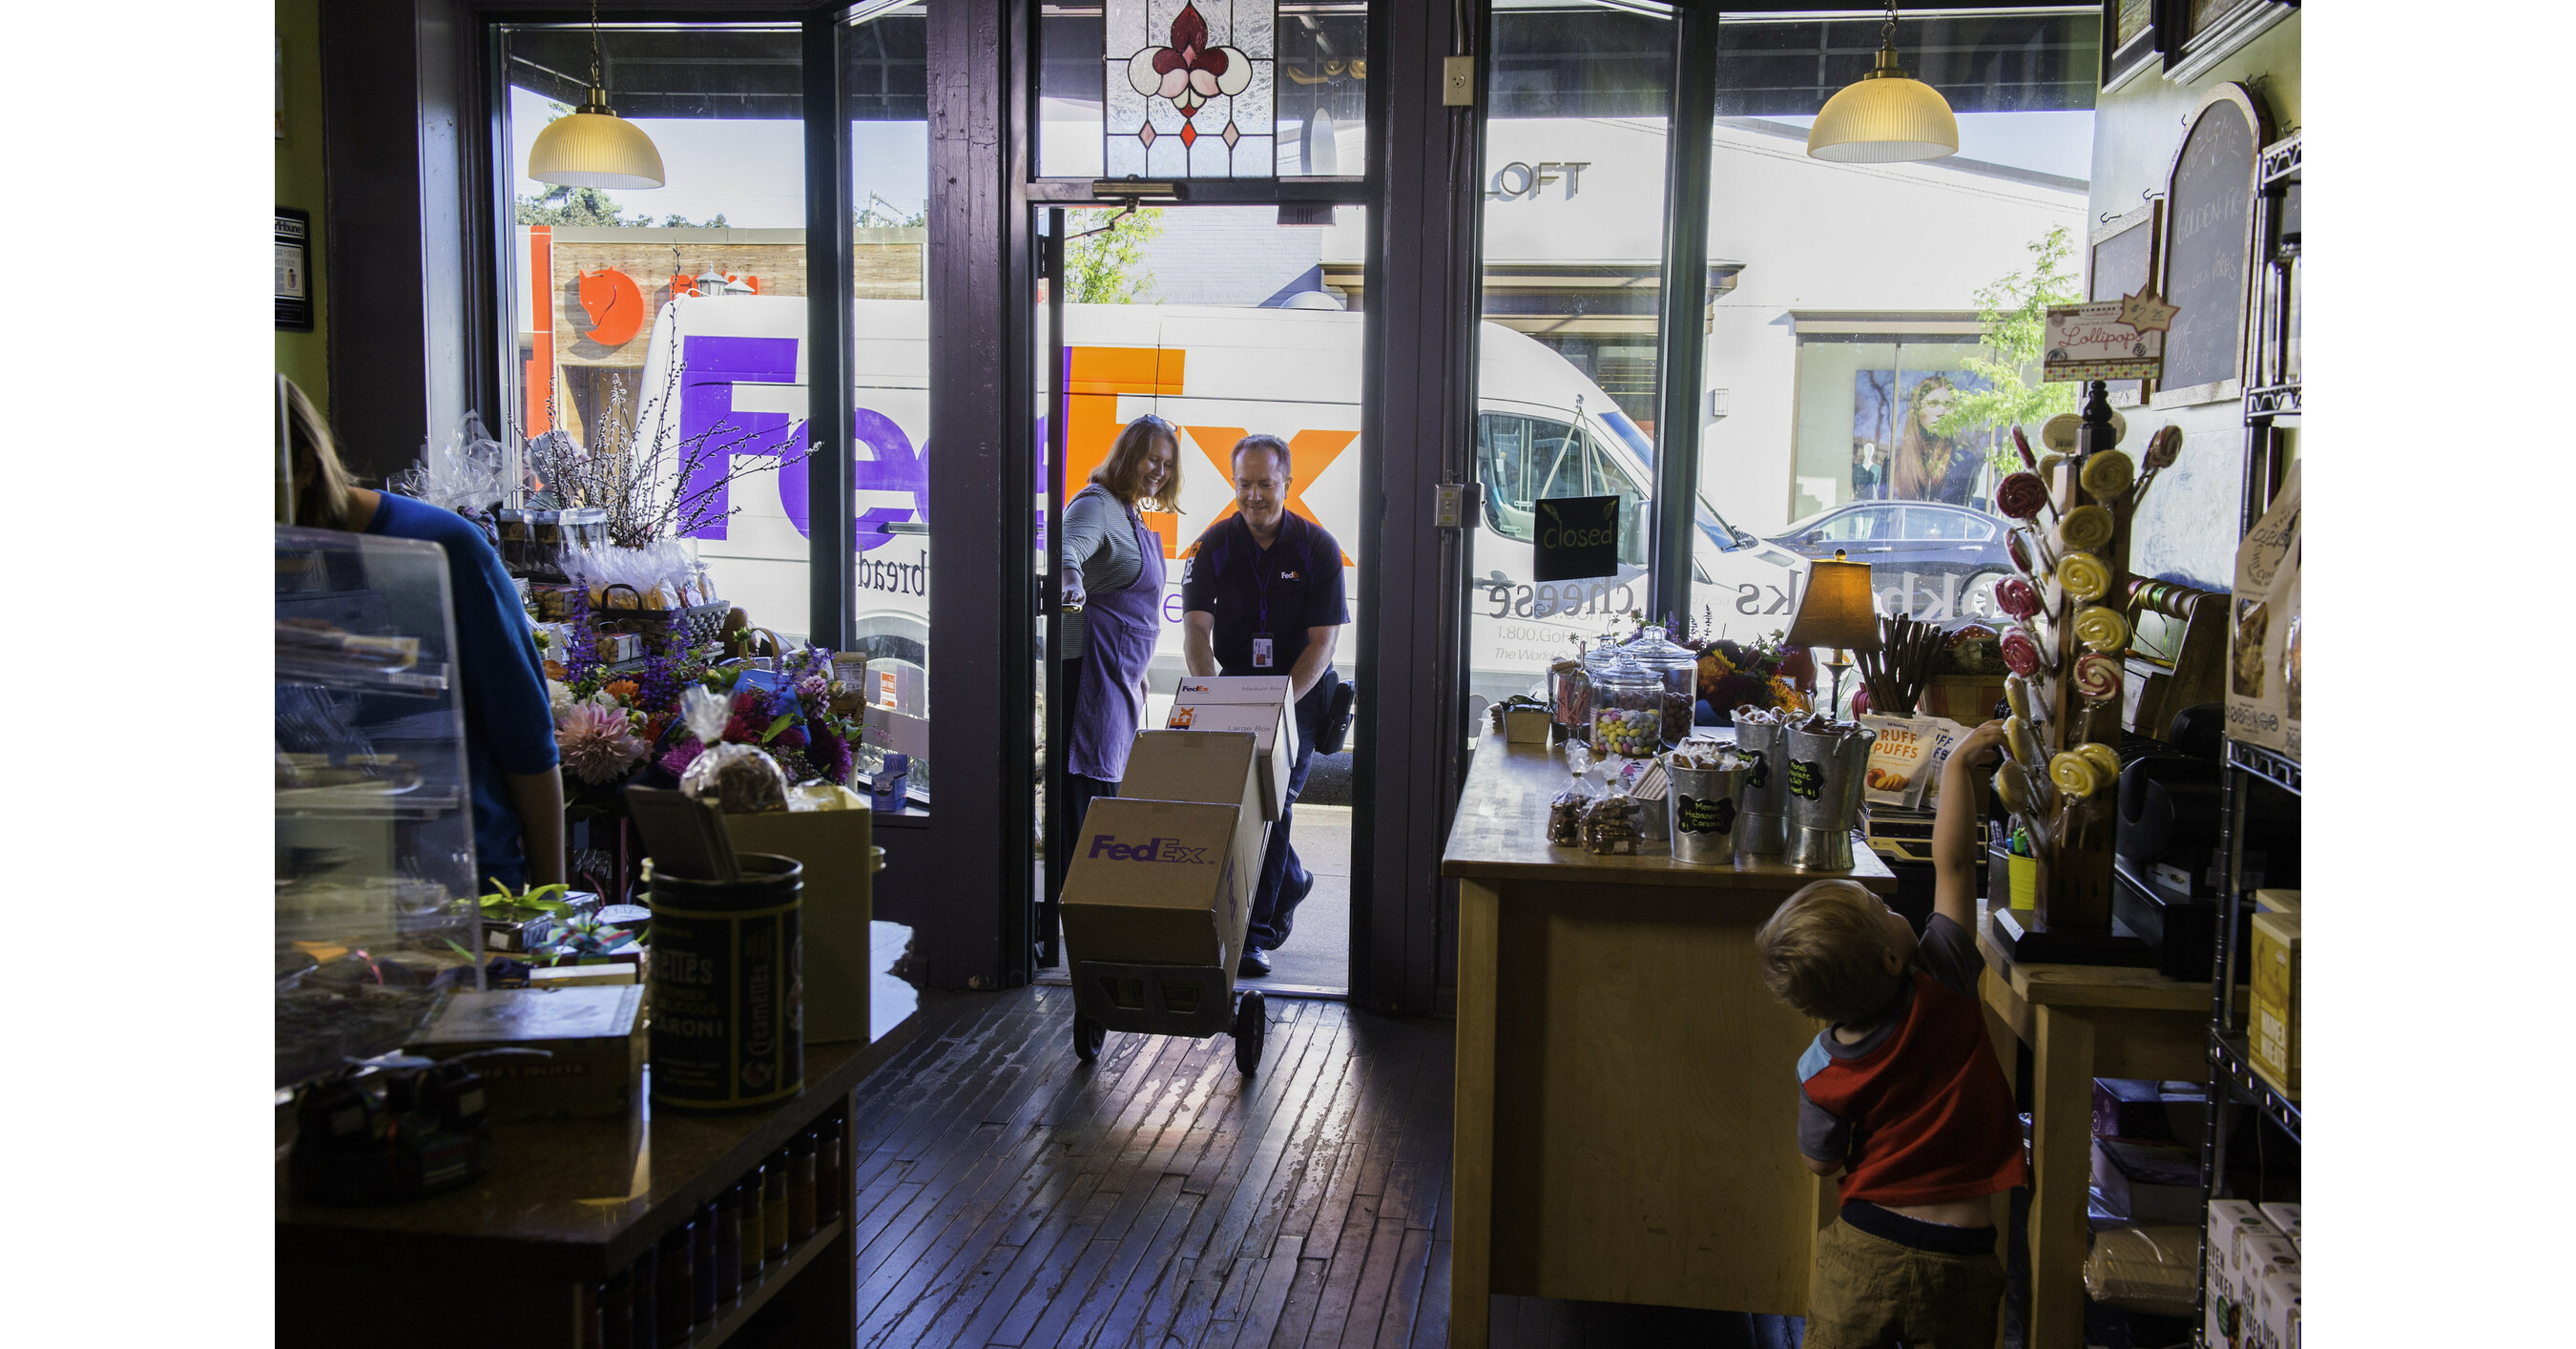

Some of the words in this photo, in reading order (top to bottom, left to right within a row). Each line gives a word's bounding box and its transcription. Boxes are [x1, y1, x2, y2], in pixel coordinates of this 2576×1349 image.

[2058, 326, 2145, 350] Lollipops
[676, 335, 1361, 567] FeEx
[1495, 648, 1517, 660] The
[1880, 729, 1917, 744] RUFF
[1874, 742, 1918, 759] PUFFS
[1088, 834, 1208, 864] FedEx
